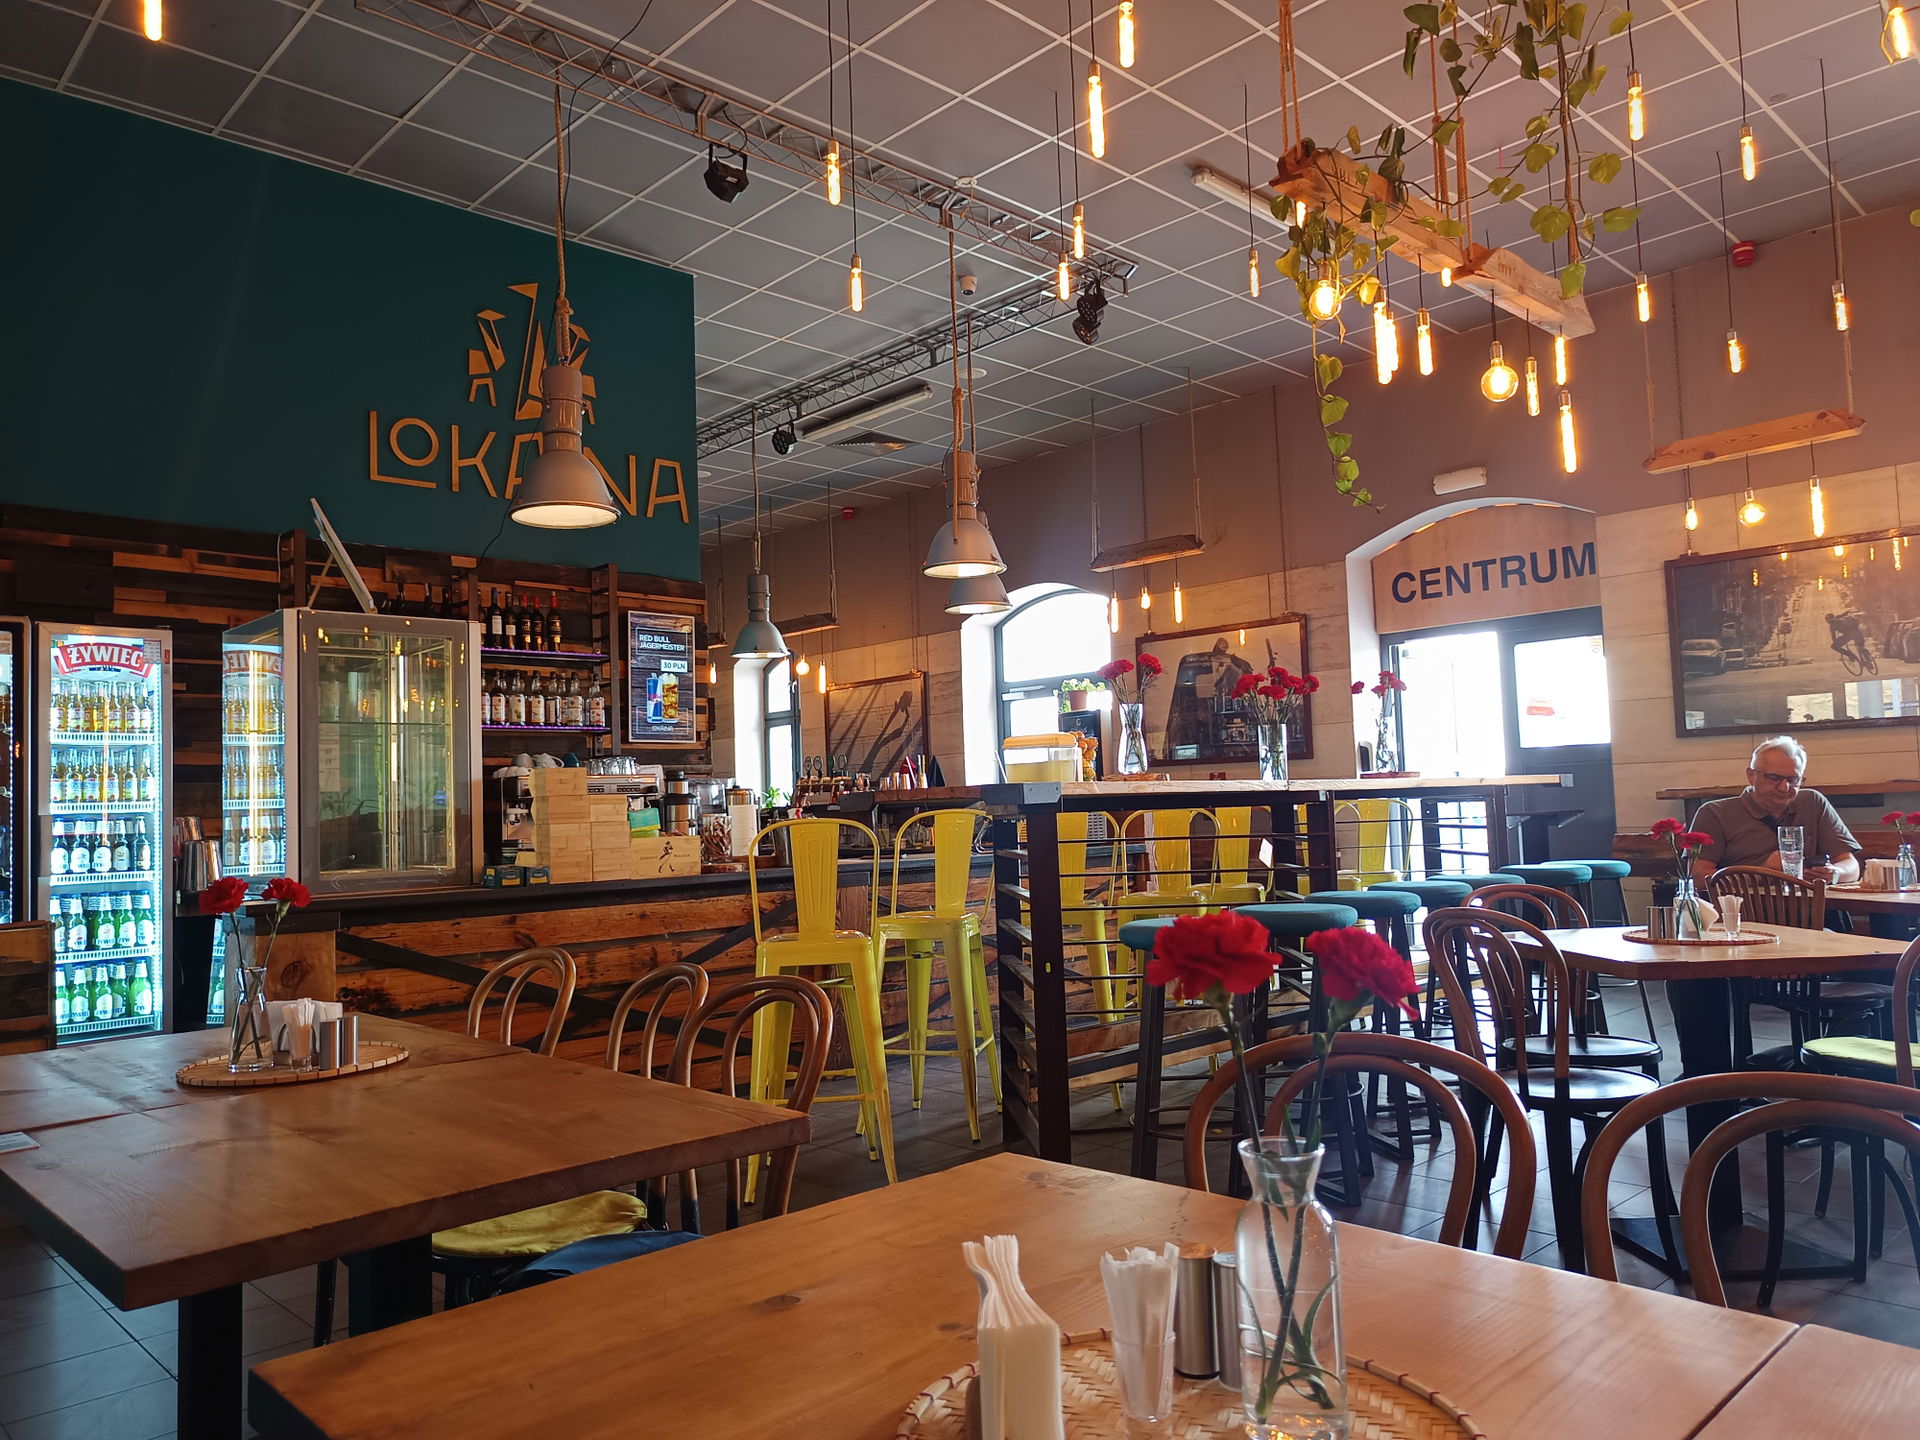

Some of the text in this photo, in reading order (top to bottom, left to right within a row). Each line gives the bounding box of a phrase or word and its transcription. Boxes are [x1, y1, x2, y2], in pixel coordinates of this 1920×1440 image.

[369, 410, 689, 523] LOKANA
[1391, 541, 1596, 603] CENTRUM
[639, 634, 671, 643] RED BULL
[67, 645, 144, 667] ŻYWIEC
[663, 661, 686, 670] 30 PLN
